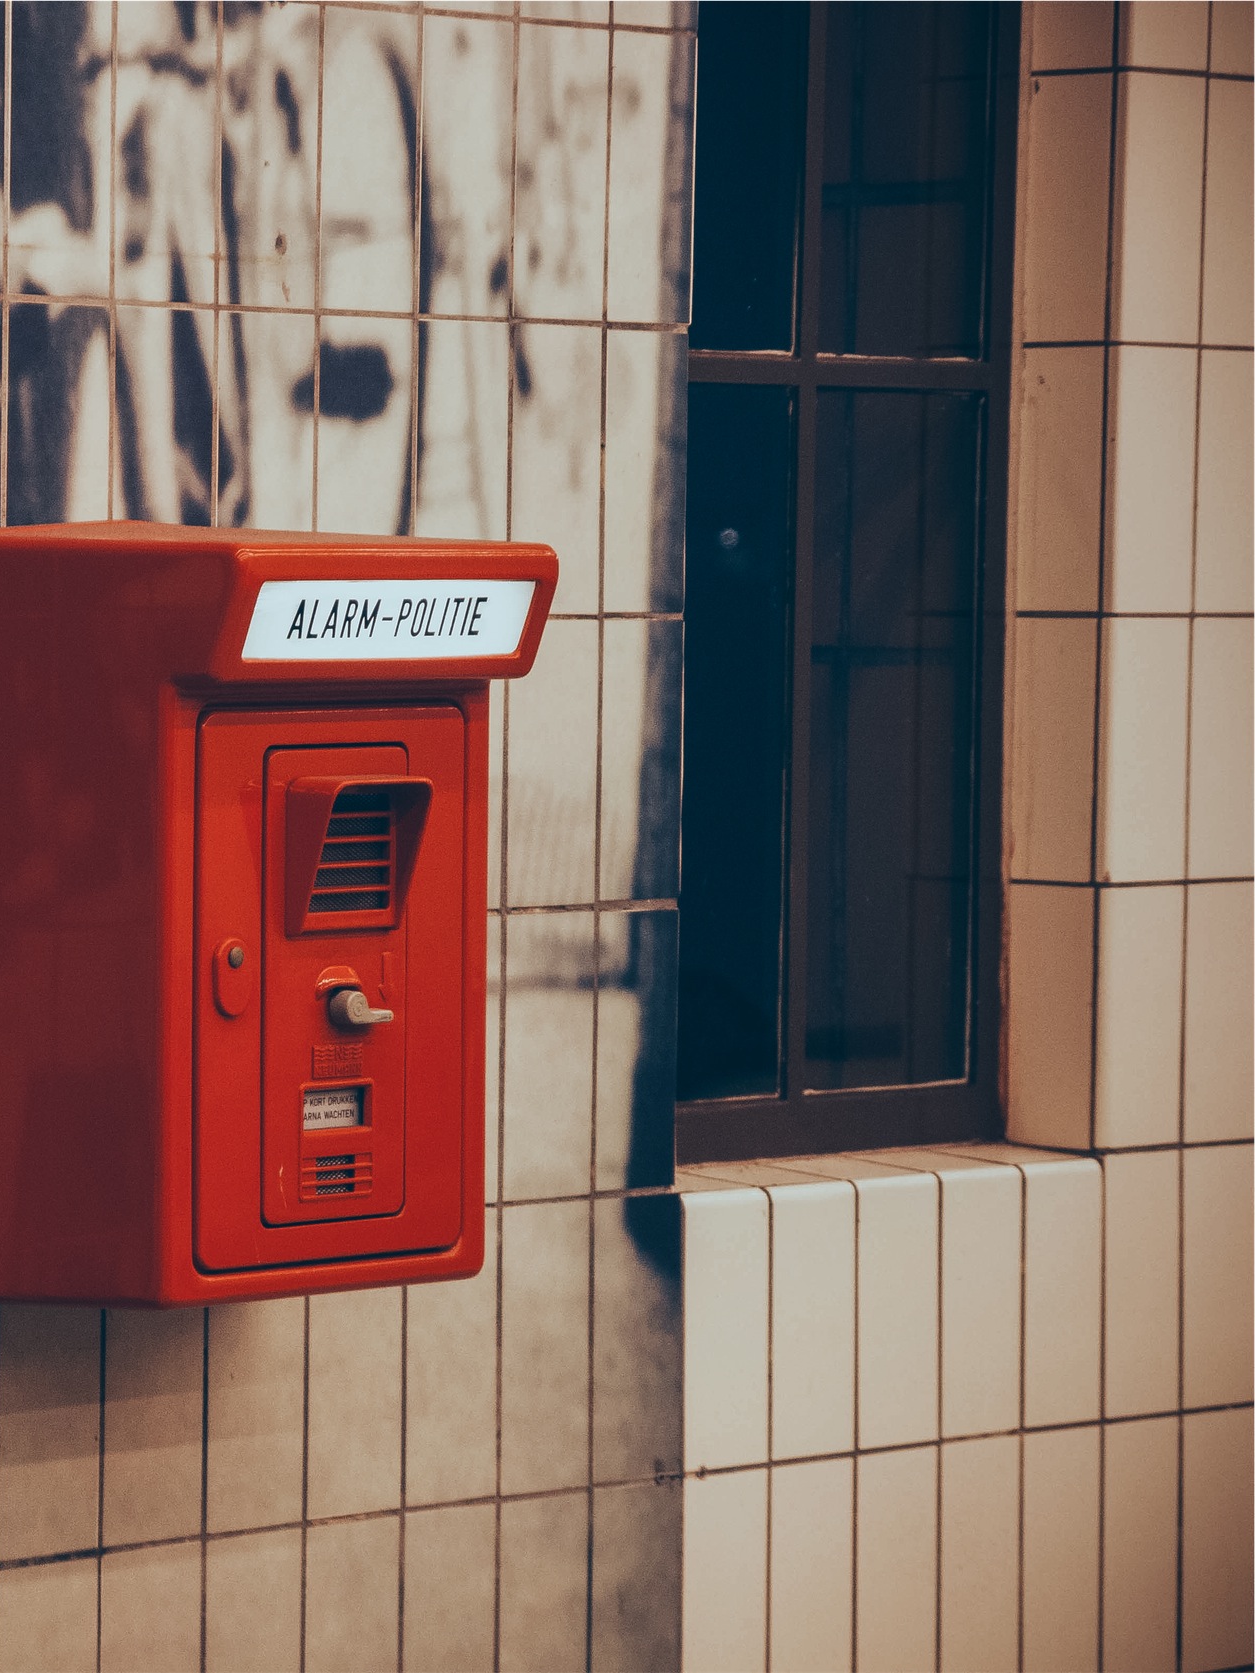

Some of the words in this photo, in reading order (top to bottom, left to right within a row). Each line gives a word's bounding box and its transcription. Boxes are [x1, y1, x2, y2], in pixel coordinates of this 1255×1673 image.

[287, 597, 488, 639] ALARM-POLITIE
[310, 1097, 326, 1106] KORT
[324, 1109, 355, 1119] WACHTEN
